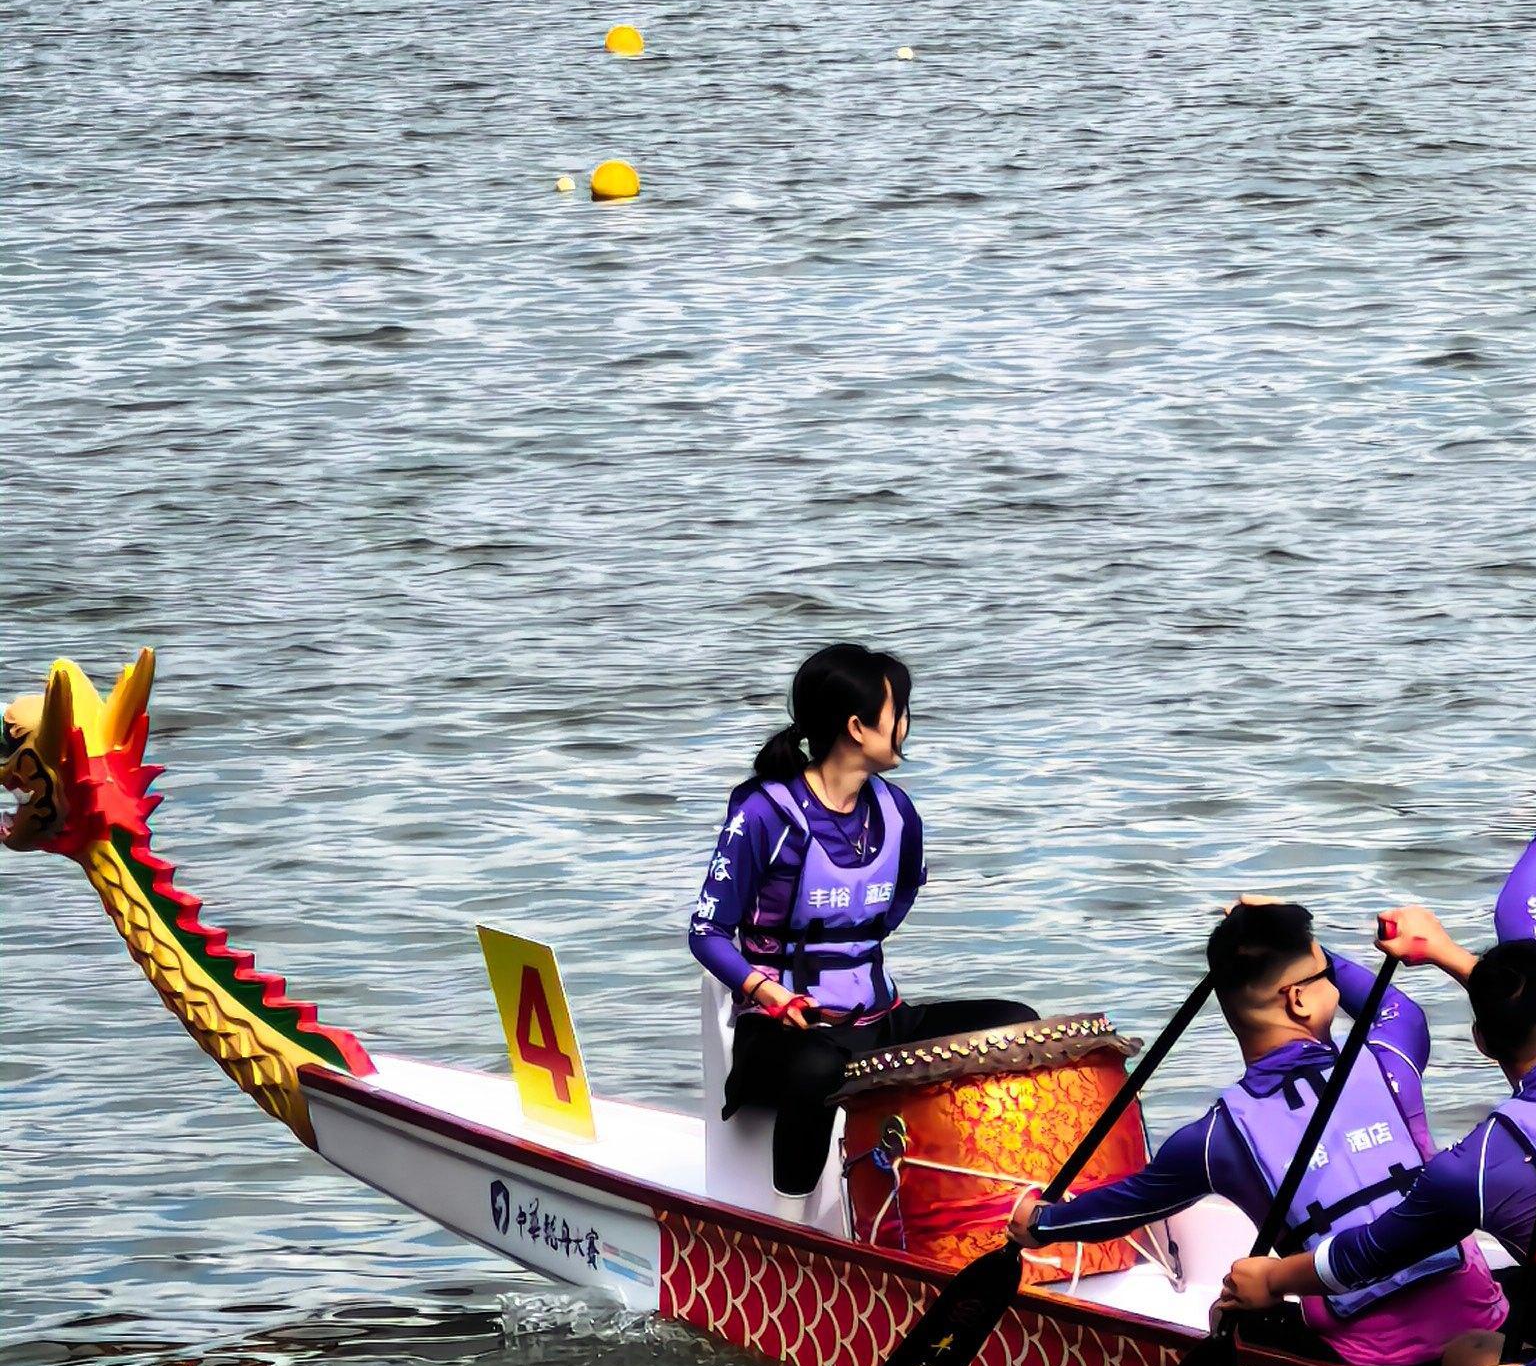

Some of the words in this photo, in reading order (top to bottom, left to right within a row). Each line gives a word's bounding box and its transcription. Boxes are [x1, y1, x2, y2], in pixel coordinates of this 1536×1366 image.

[808, 888, 851, 909] 丰裕
[865, 881, 894, 906] 酒店
[516, 965, 575, 1103] 4
[1345, 1121, 1393, 1153] 酒店
